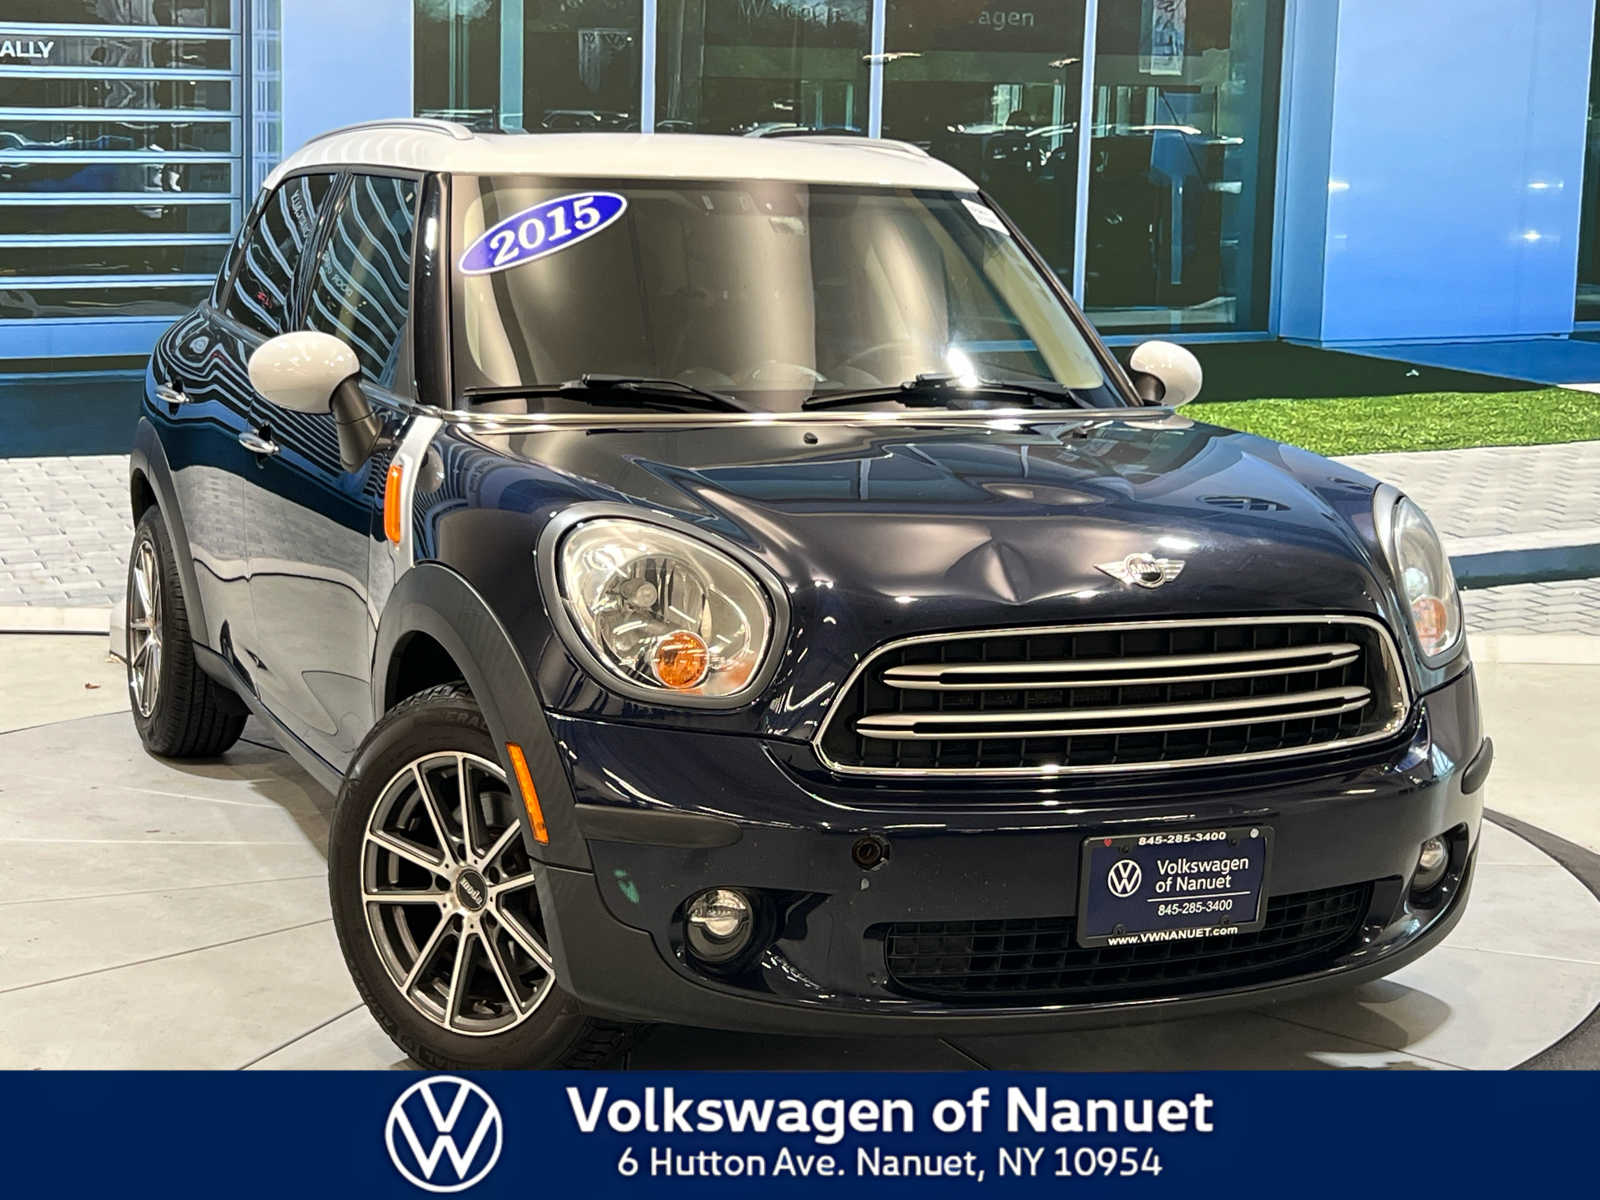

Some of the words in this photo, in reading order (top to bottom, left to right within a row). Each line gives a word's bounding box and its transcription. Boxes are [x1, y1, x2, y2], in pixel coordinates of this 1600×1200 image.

[0, 40, 54, 58] ALLY
[489, 196, 601, 267] 2015
[1138, 831, 1227, 846] 845-285-3400
[1157, 857, 1249, 876] Volkswagen
[1155, 878, 1173, 893] of
[1176, 874, 1232, 892] Nanuet
[1157, 899, 1233, 916] 845-285-3400
[1108, 926, 1238, 946] www.VWNANUET.com
